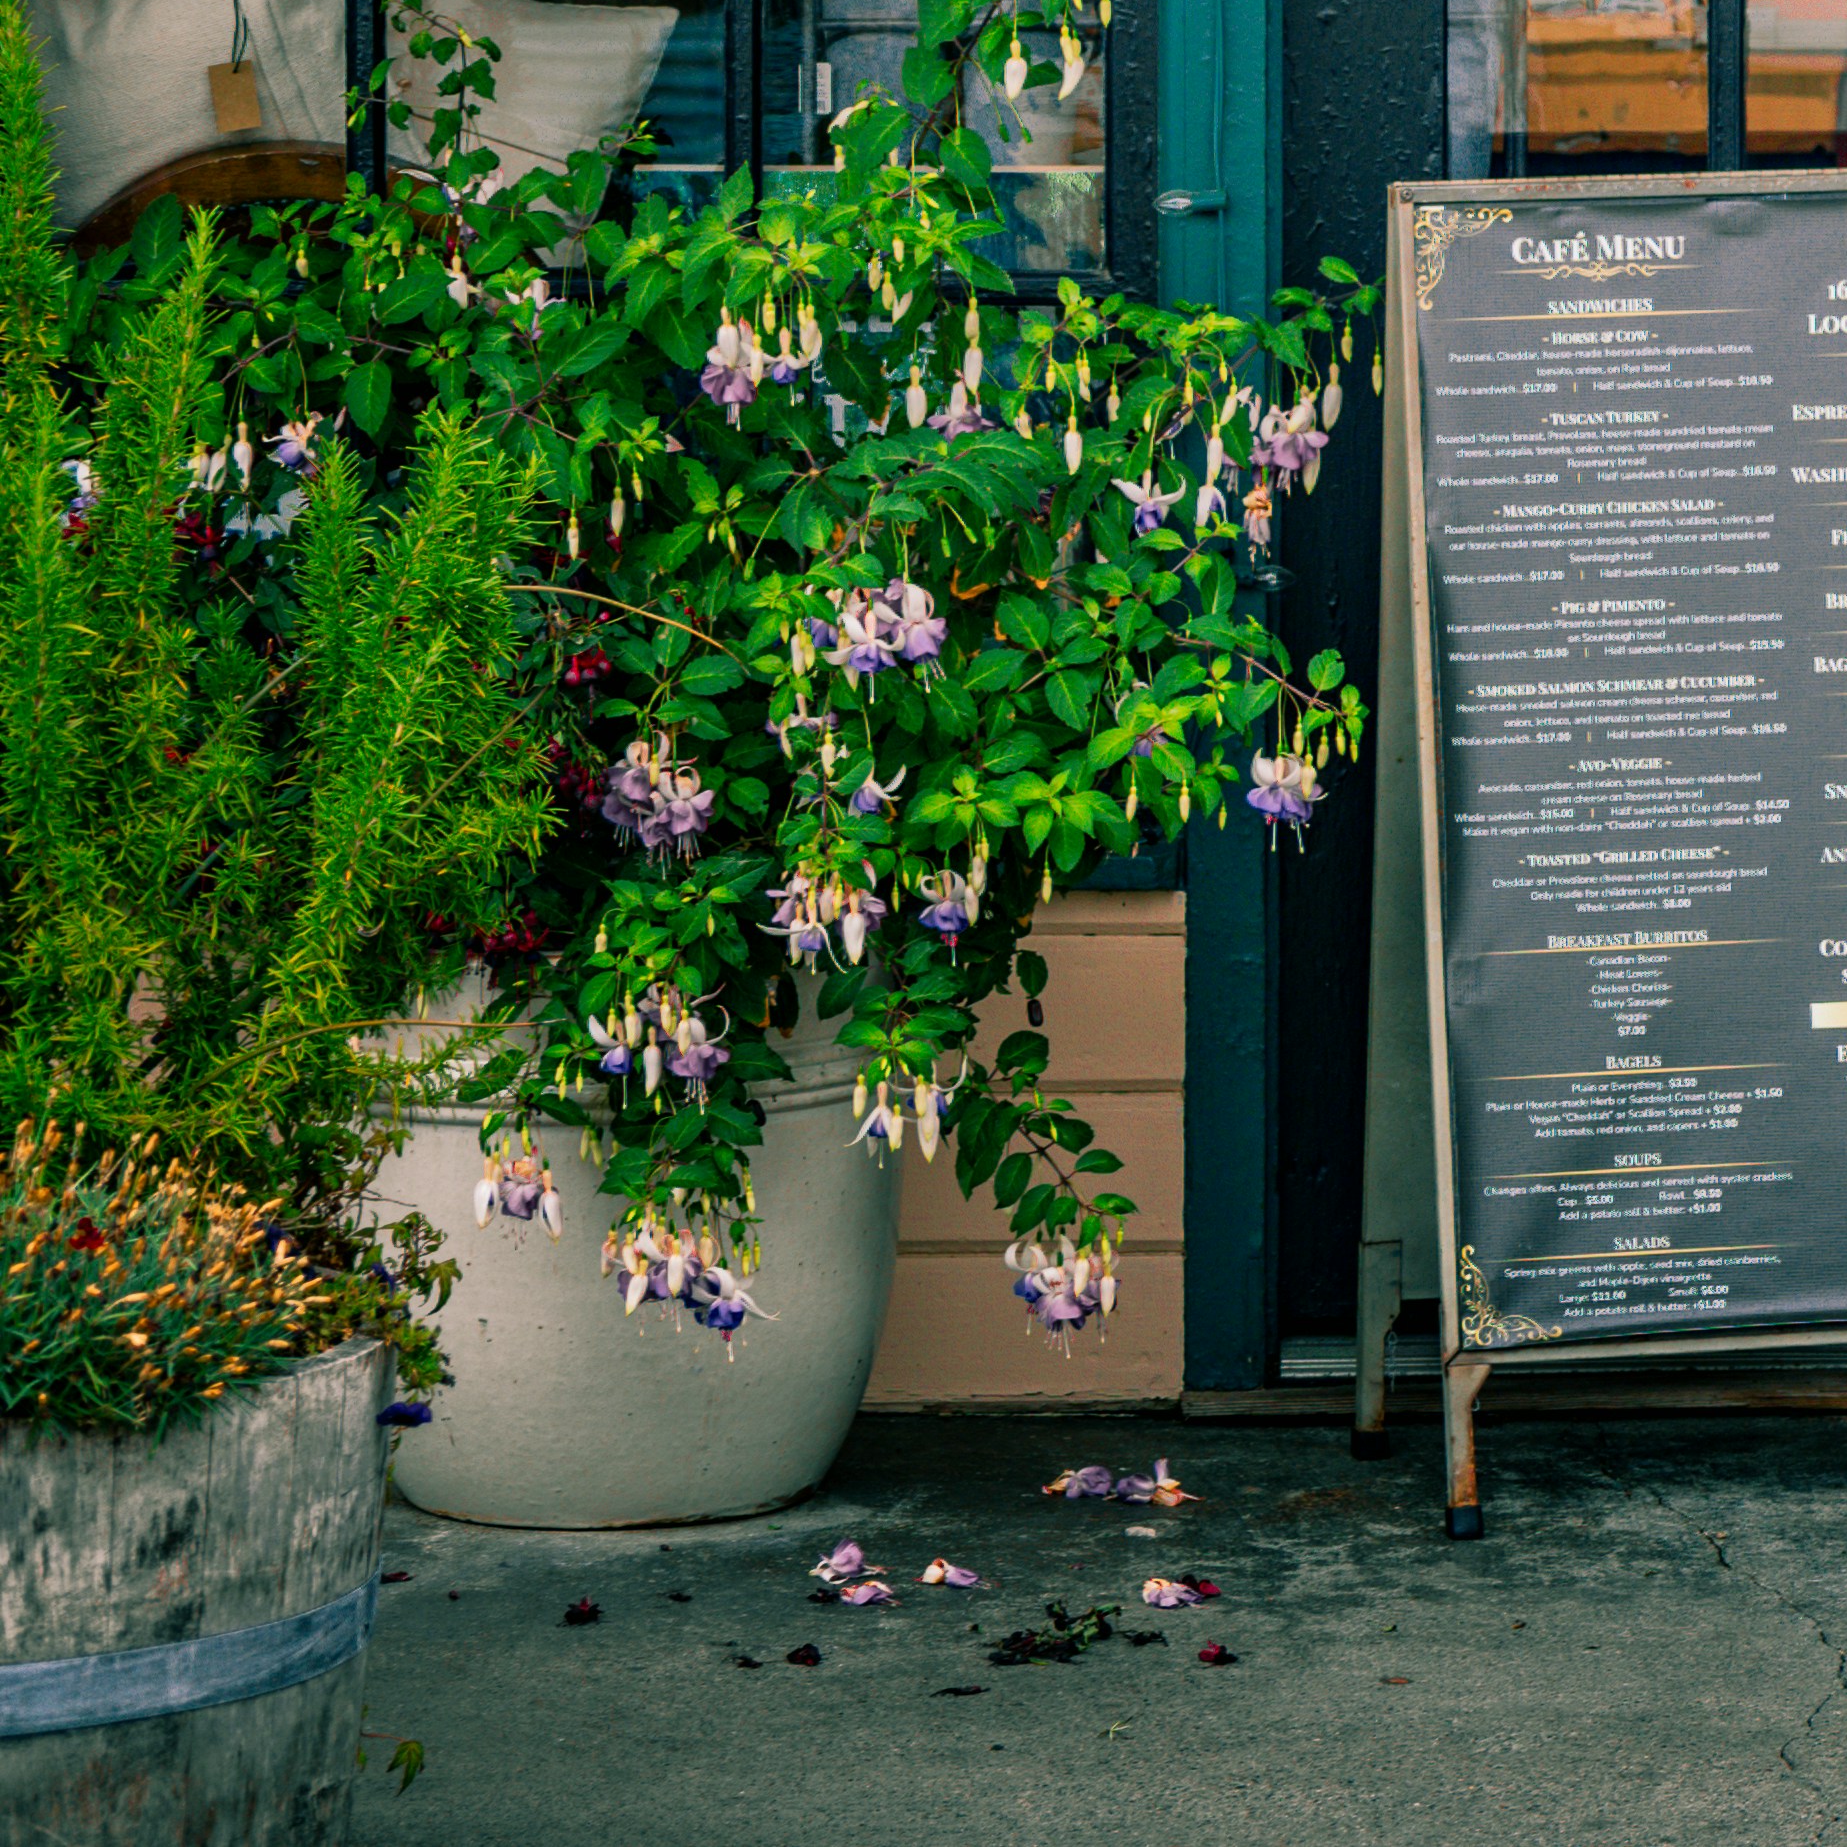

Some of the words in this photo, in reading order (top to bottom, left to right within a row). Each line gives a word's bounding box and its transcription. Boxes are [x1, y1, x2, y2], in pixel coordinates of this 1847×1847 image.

[1512, 231, 1589, 264] CAFÉ
[1596, 234, 1685, 260] MENU
[1548, 298, 1654, 314] SANDWICHES
[1549, 413, 1603, 425] TUSCAN
[1606, 411, 1660, 423] TURKEY
[1547, 934, 1631, 949] BREAKFAST
[1635, 930, 1708, 944] BURRITOS
[1605, 1055, 1661, 1069] BAGELS
[1613, 1154, 1662, 1167] SOUPS
[1613, 1237, 1670, 1249] SALADS
